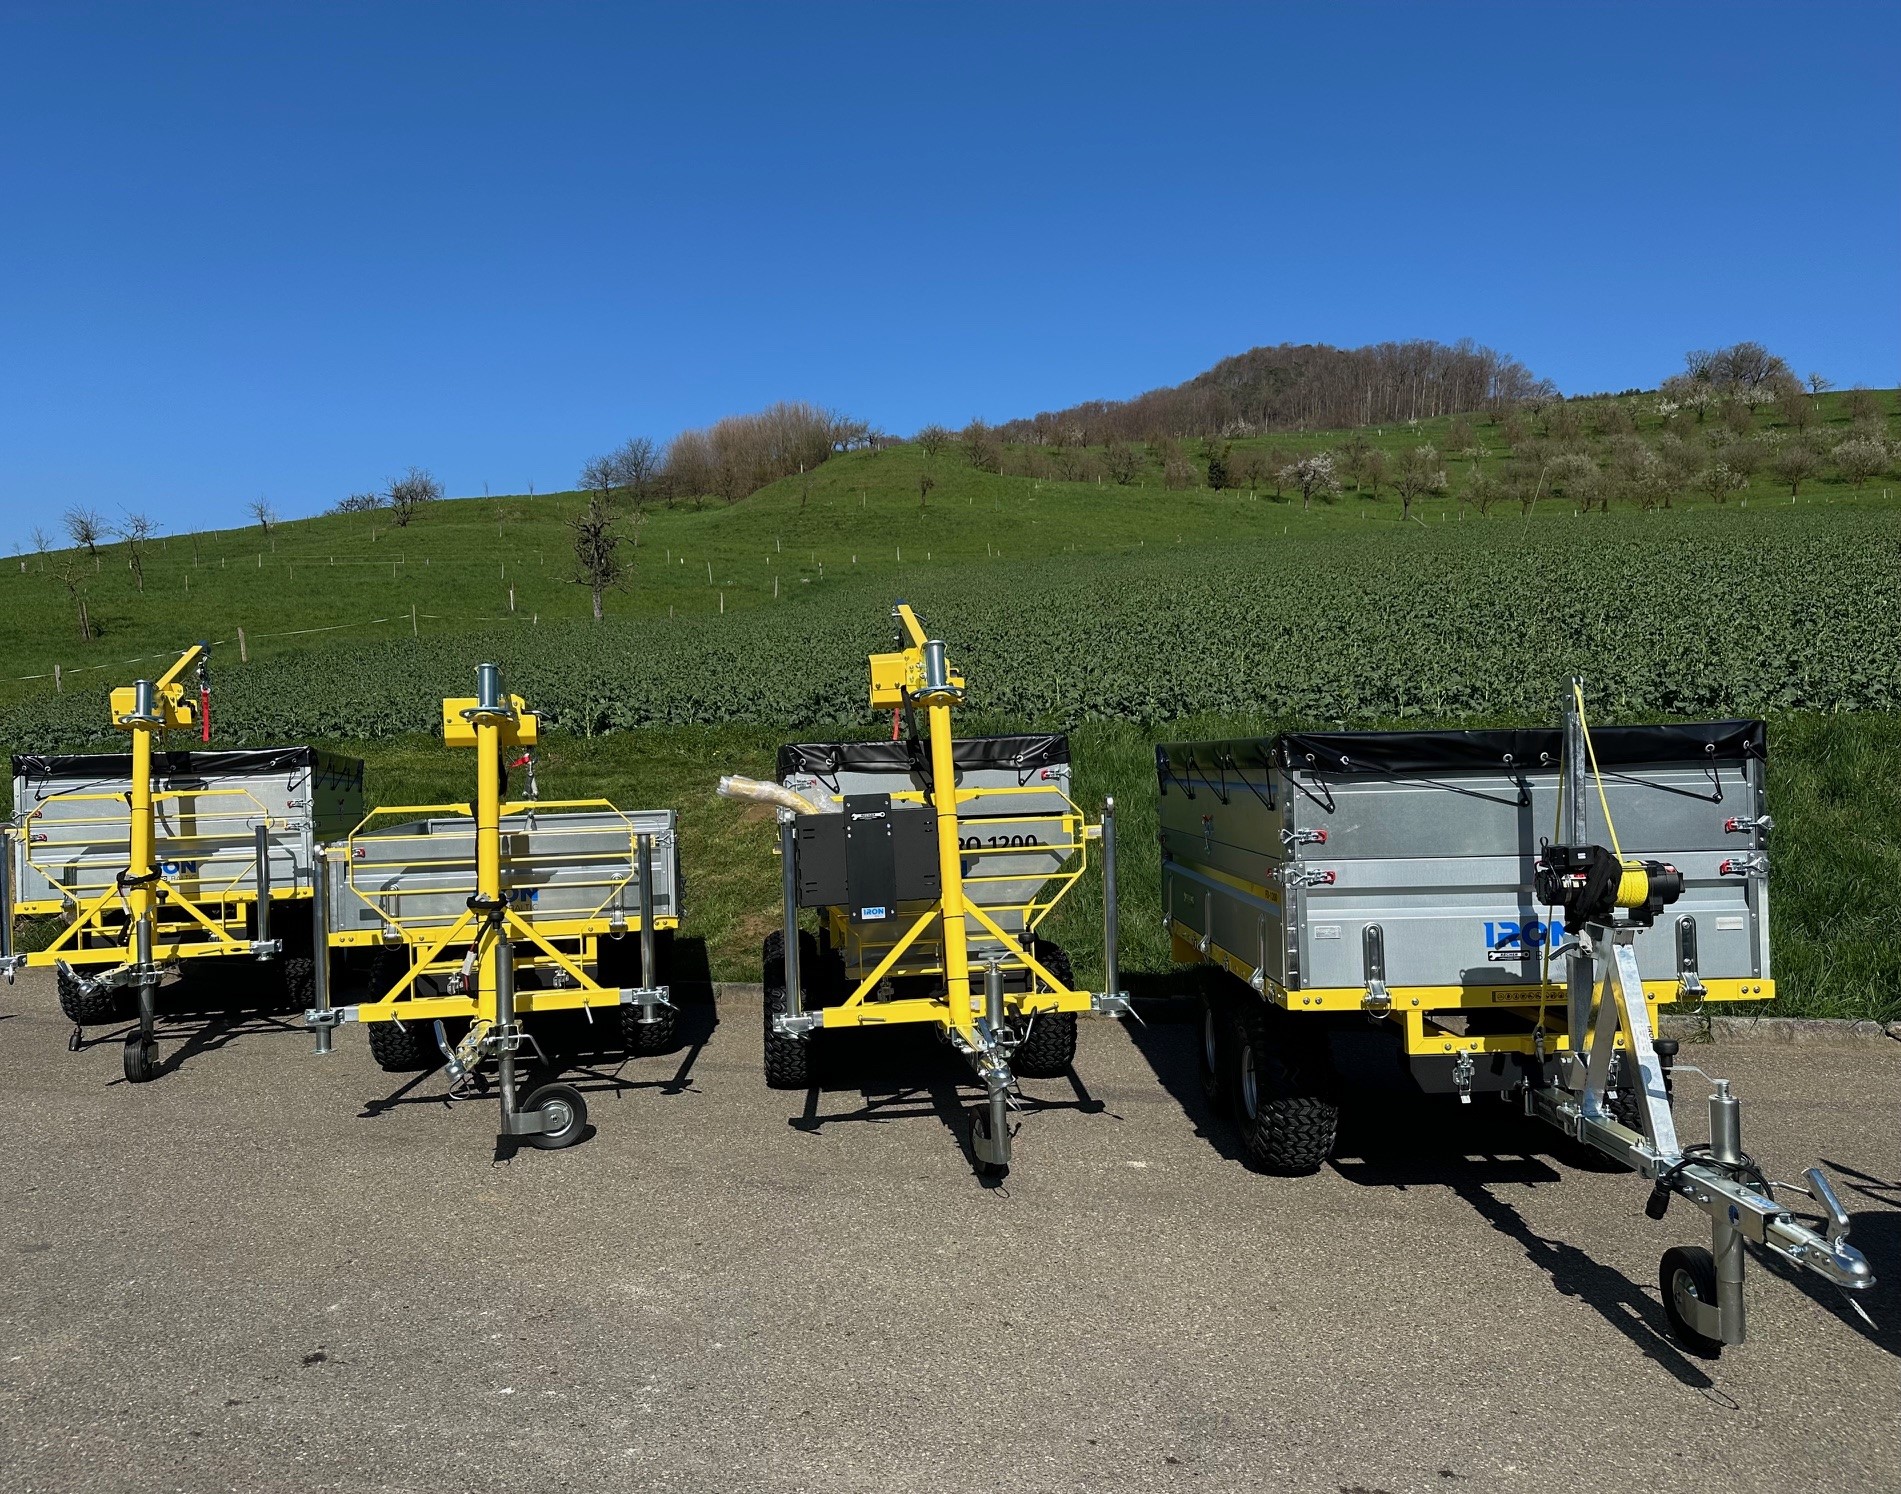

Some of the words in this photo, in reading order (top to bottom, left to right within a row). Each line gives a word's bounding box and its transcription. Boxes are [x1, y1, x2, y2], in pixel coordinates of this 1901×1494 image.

[987, 834, 1038, 852] 1200
[863, 908, 884, 916] IRON
[1483, 920, 1566, 948] IRON
